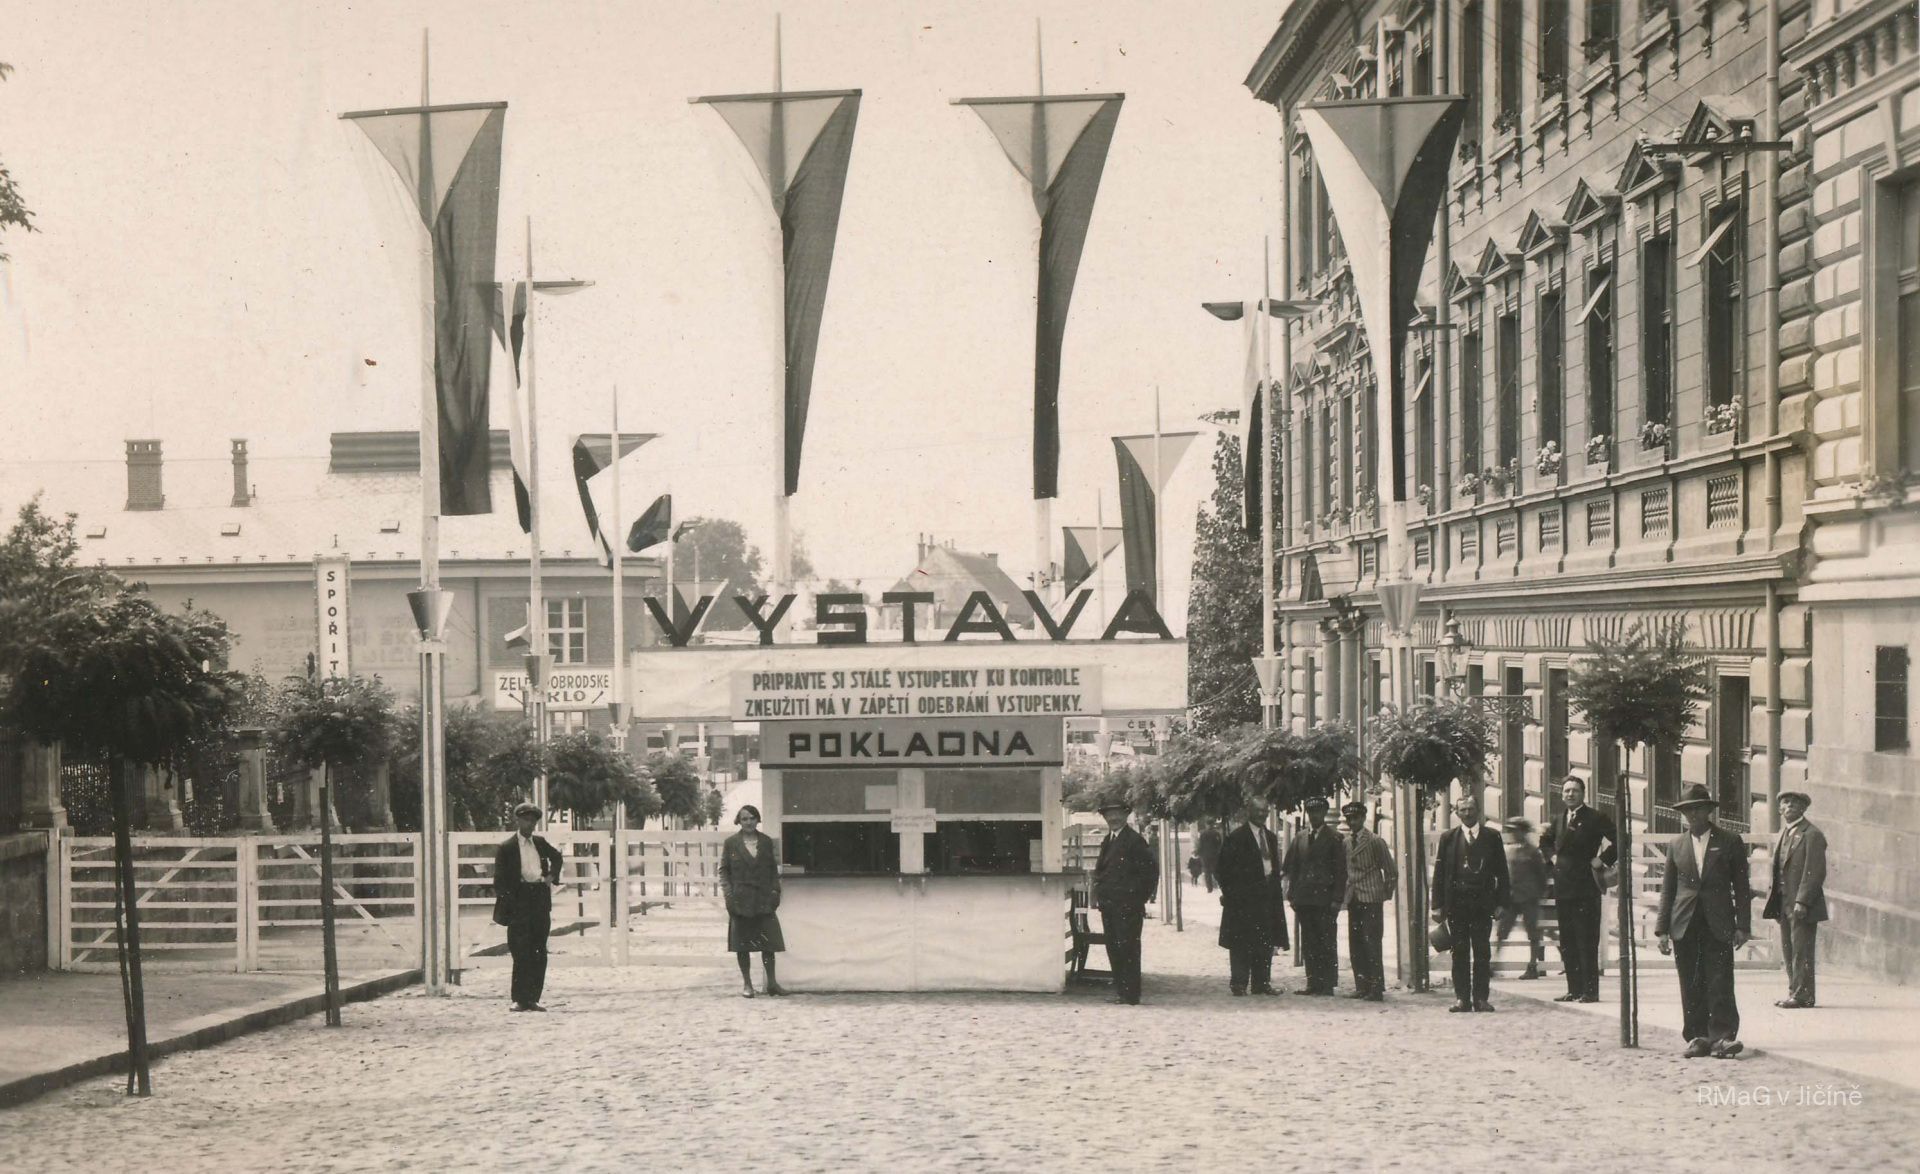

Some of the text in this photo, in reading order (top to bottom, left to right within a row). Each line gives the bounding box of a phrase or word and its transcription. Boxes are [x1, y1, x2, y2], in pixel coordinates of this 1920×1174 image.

[832, 671, 845, 689] SI
[850, 667, 892, 689] STÁLÉ
[898, 670, 979, 688] VSTUPENKY
[986, 669, 1005, 687] KU
[1010, 668, 1080, 687] KONTROLE
[745, 691, 1082, 717] ZNEUŽITÍ MÁ V ZÁPĚTÍ ODEBRÁNÍ VSTUPENKY.
[789, 731, 1034, 758] POKLADNA
